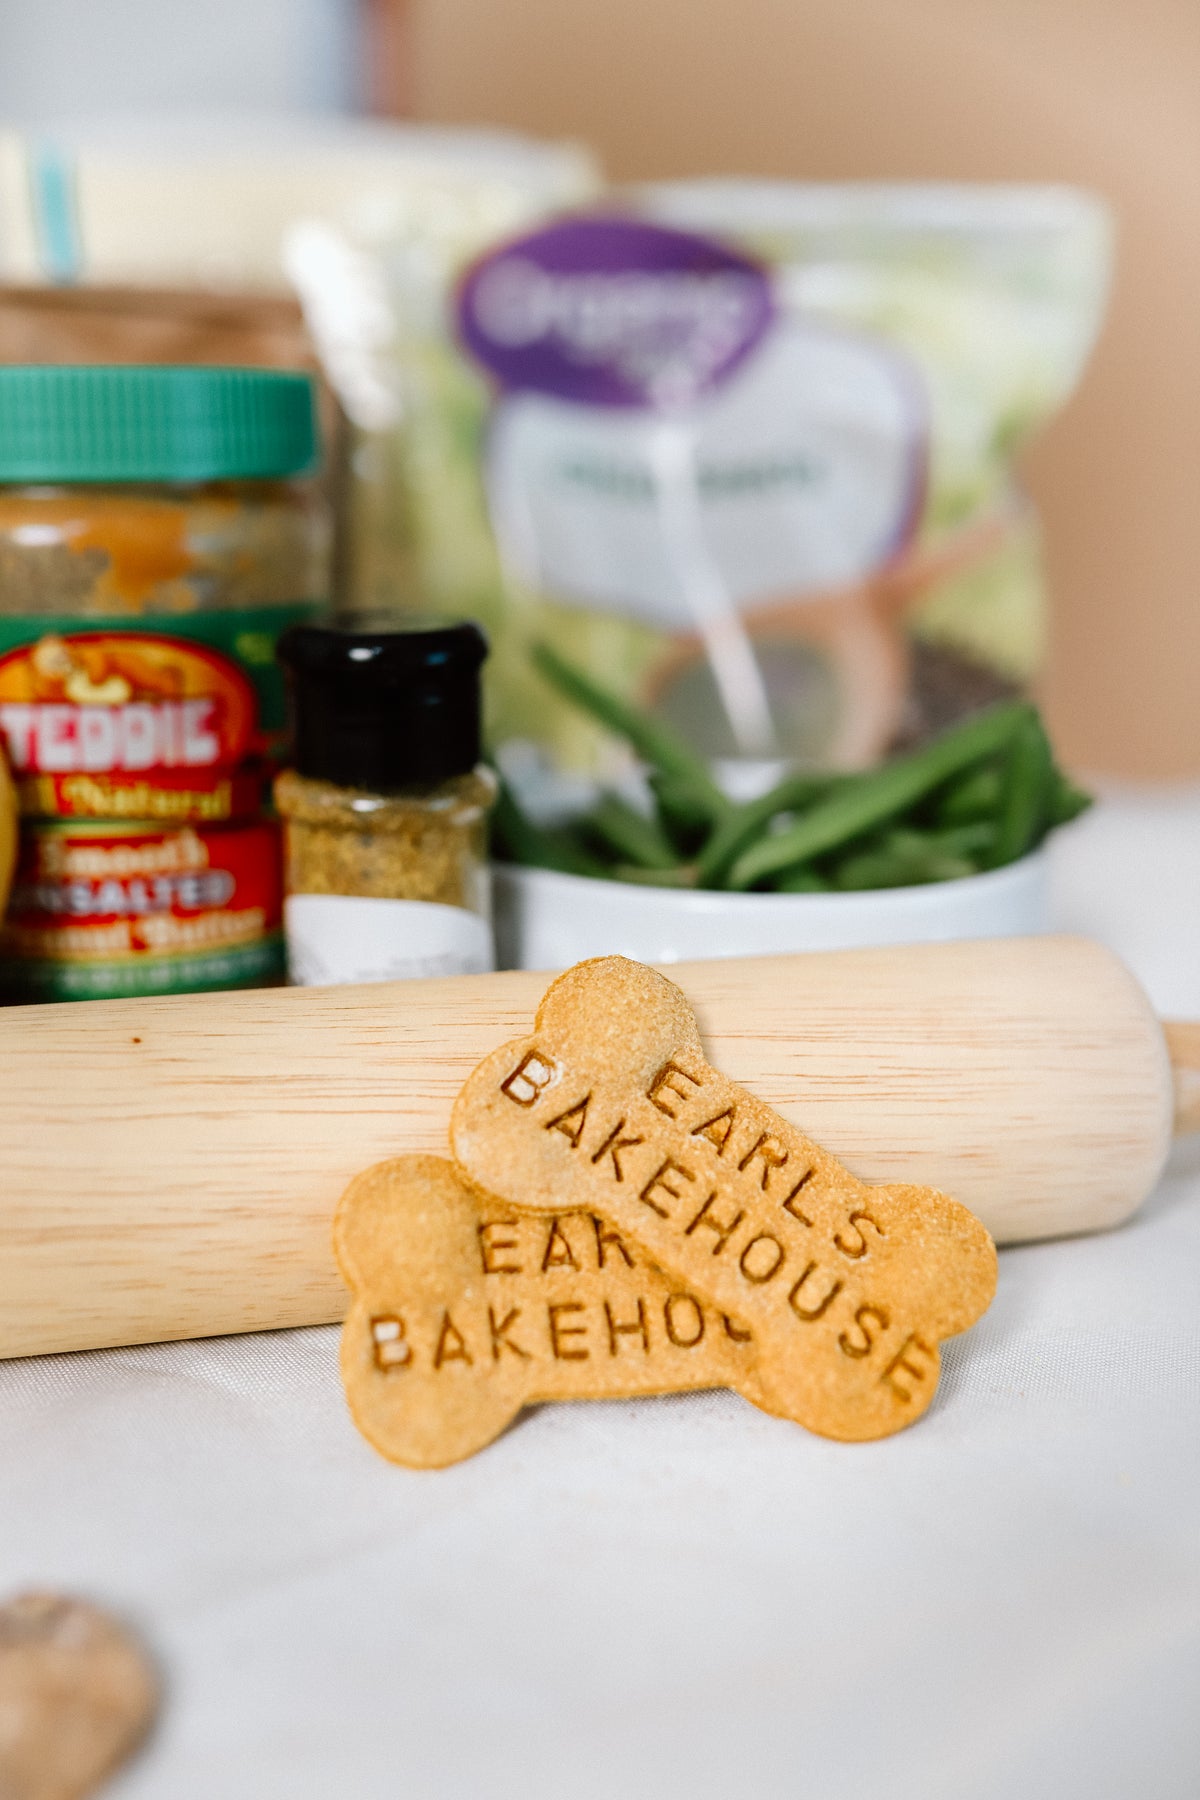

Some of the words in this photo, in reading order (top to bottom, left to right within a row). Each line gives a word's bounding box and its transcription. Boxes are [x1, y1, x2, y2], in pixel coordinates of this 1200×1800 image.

[0, 699, 220, 772] TEDDIE
[500, 1050, 937, 1404] BAKEHOUSE
[647, 1061, 885, 1260] EARLS
